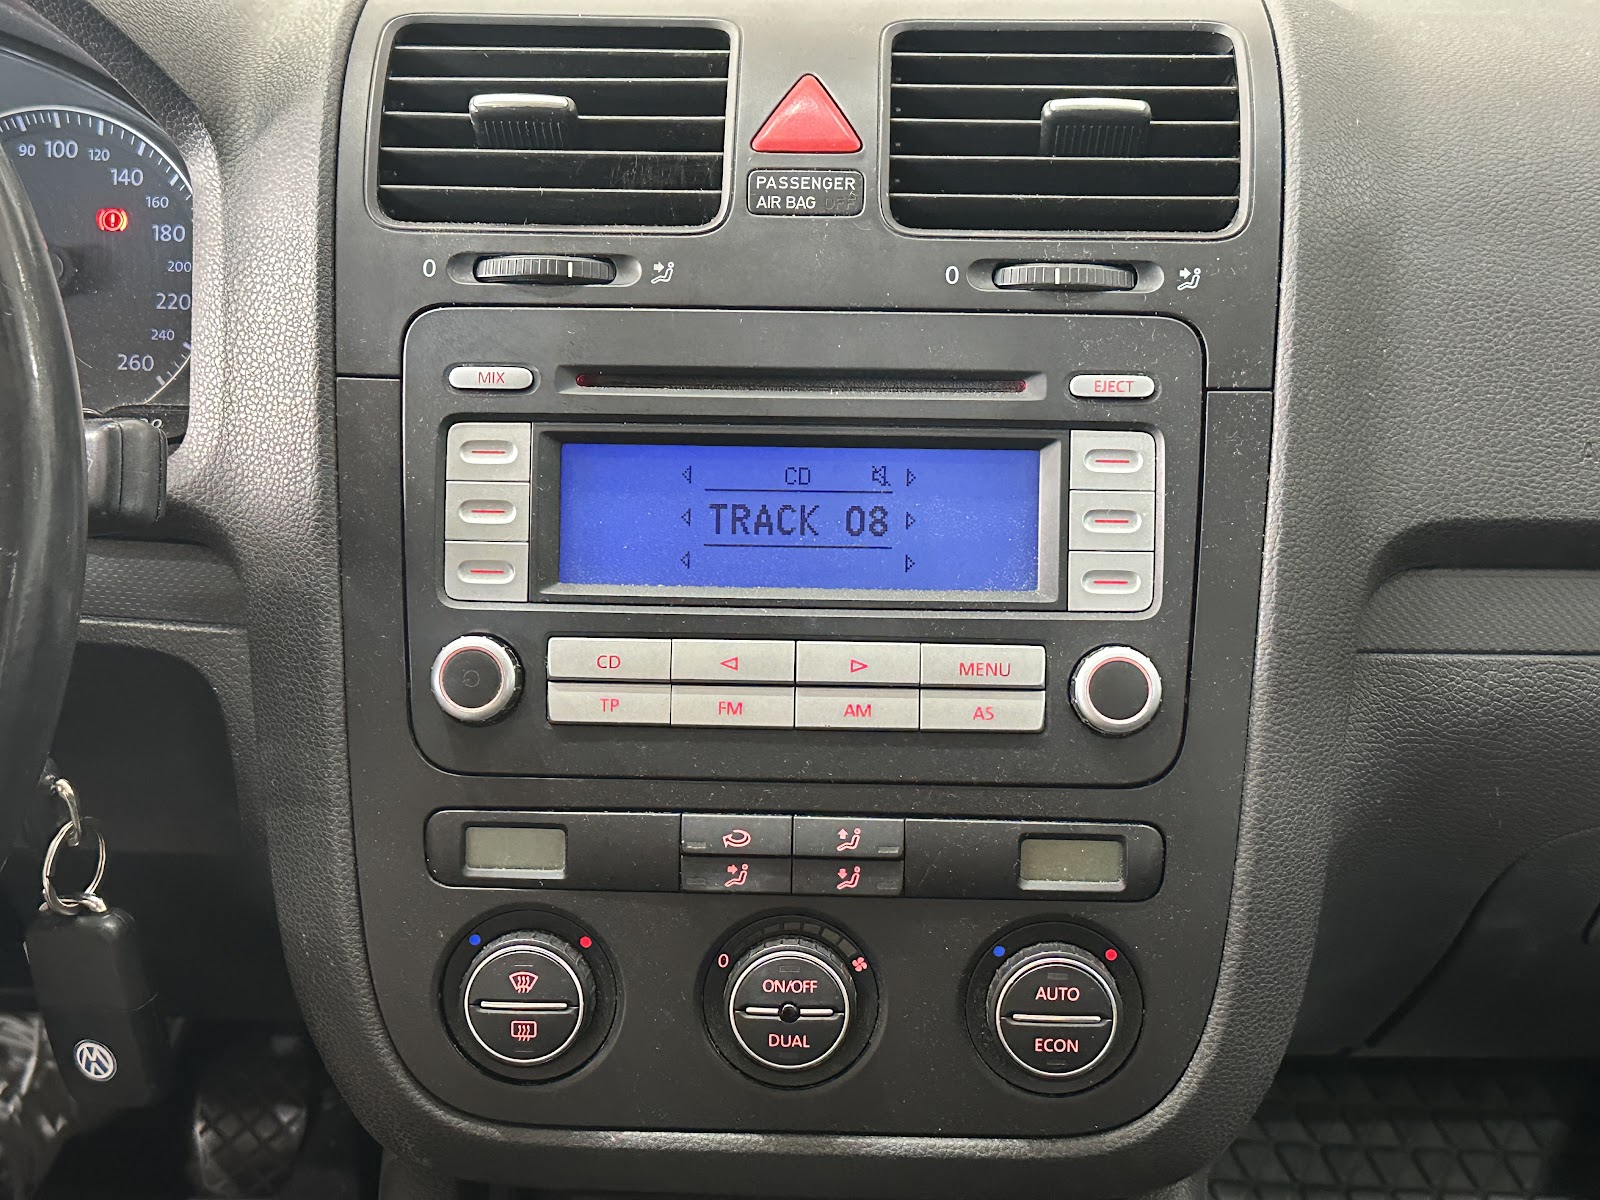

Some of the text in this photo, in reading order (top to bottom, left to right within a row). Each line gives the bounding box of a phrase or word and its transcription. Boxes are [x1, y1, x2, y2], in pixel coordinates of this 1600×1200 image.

[18, 144, 36, 157] 90
[45, 139, 79, 159] 100
[88, 148, 110, 162] 120
[110, 168, 144, 187] 140
[756, 176, 856, 191] PASSENGER
[145, 196, 169, 209] 160
[756, 195, 781, 209] AIR
[786, 195, 816, 209] BAG
[152, 224, 186, 243] 180
[167, 260, 192, 273] 200
[422, 259, 437, 278] 0
[944, 265, 960, 285] 0
[155, 292, 191, 311] 220
[151, 329, 175, 341] 240
[117, 353, 154, 372] 260
[478, 371, 505, 385] MIX
[1093, 379, 1135, 394] EJECT
[784, 466, 811, 486] CD
[708, 503, 888, 537] TRACK 08
[596, 655, 621, 669] CD
[959, 662, 1011, 677] MENU
[600, 698, 620, 713] TP
[718, 701, 743, 716] FM
[843, 703, 872, 718] AM
[972, 706, 995, 721] AS
[717, 953, 730, 968] 0
[762, 979, 818, 994] ON/OFF
[1035, 986, 1080, 1001] AUTO
[768, 1033, 810, 1048] DUAL
[1034, 1037, 1079, 1053] ECON
